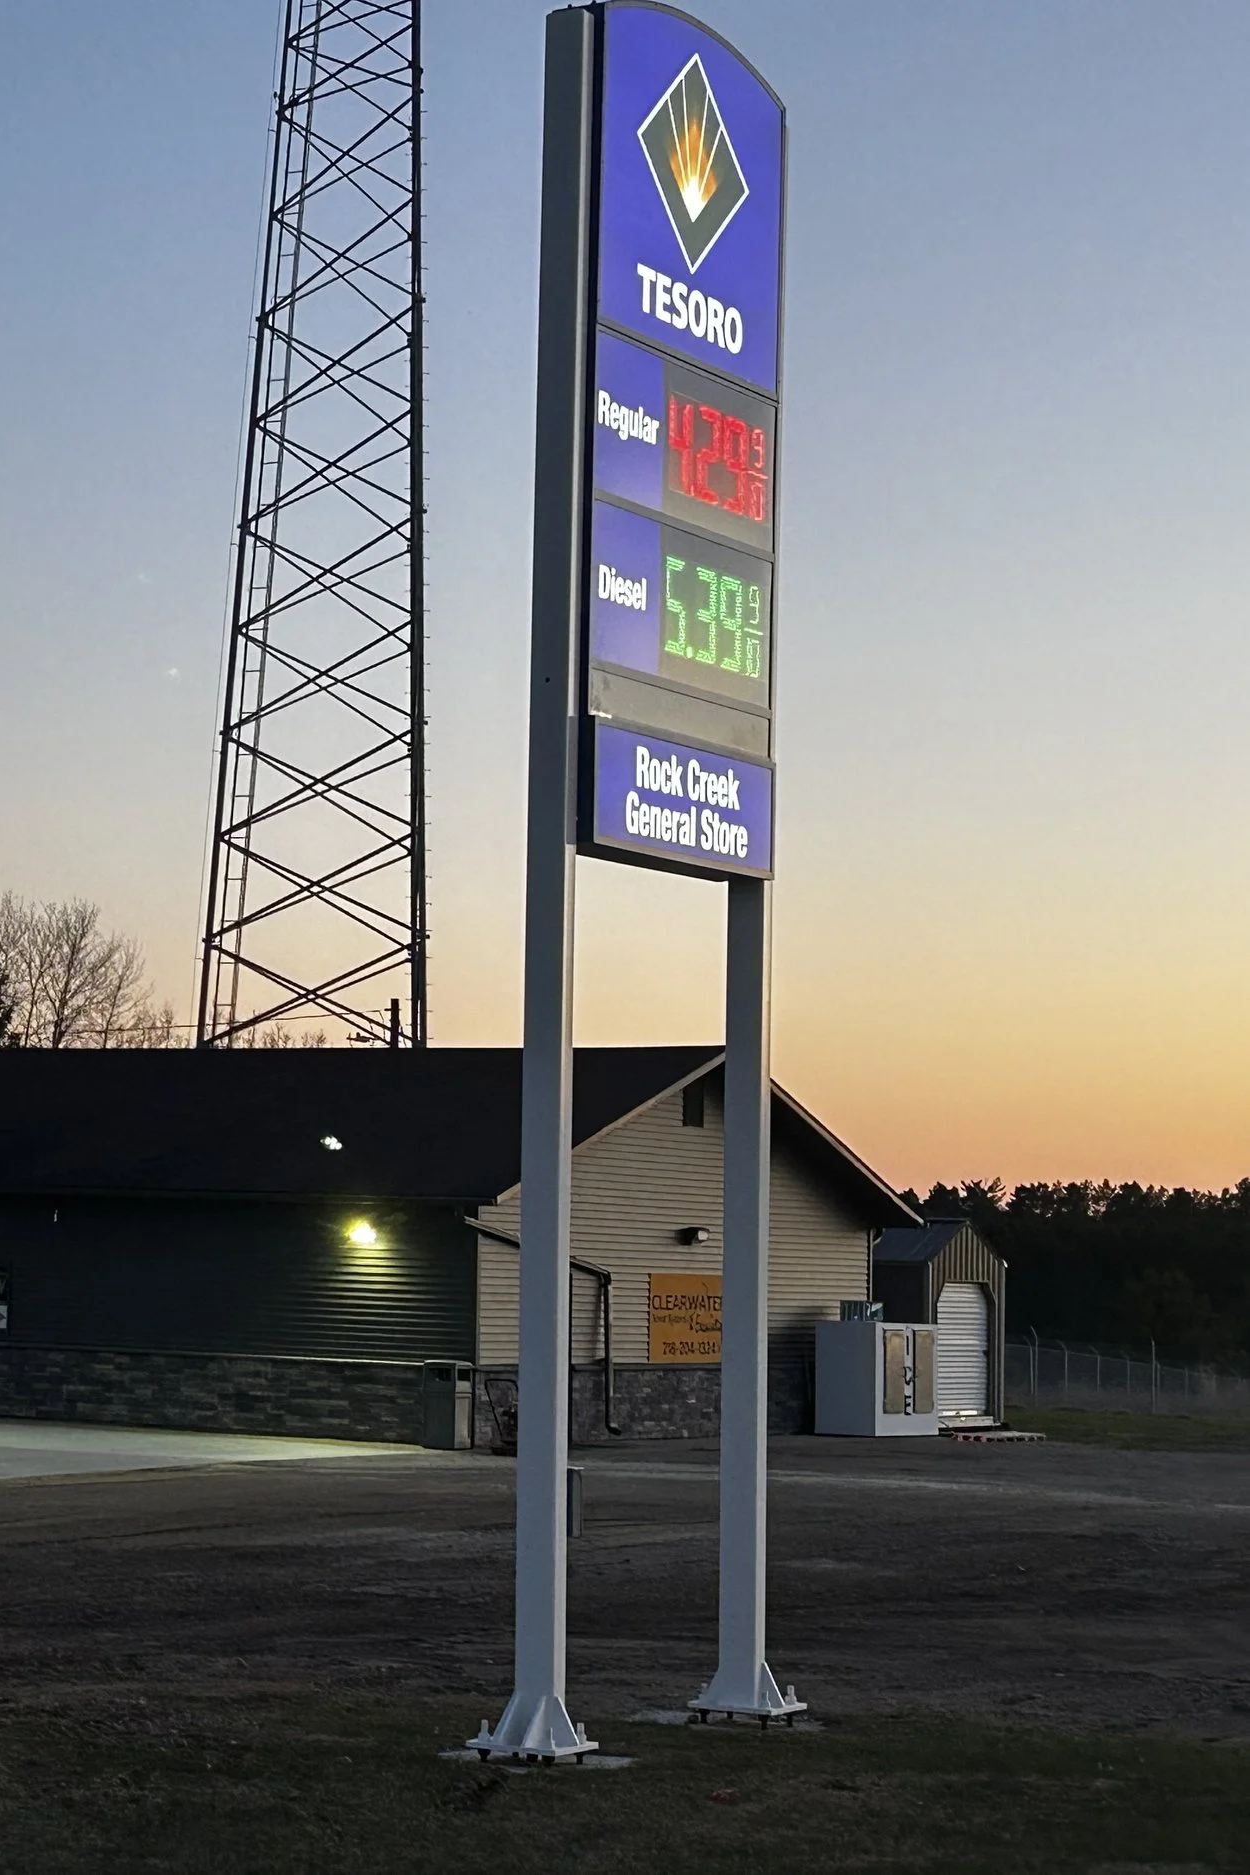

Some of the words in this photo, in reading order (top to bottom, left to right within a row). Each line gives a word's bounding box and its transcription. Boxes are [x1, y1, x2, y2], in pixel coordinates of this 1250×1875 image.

[637, 262, 743, 354] TESORO
[598, 390, 659, 445] Regular
[598, 564, 647, 611] Diesel
[636, 745, 684, 798] Rock
[687, 758, 741, 811] Creek
[625, 791, 697, 847] General
[700, 809, 748, 859] Store
[652, 1294, 722, 1311] CLEARWATE
